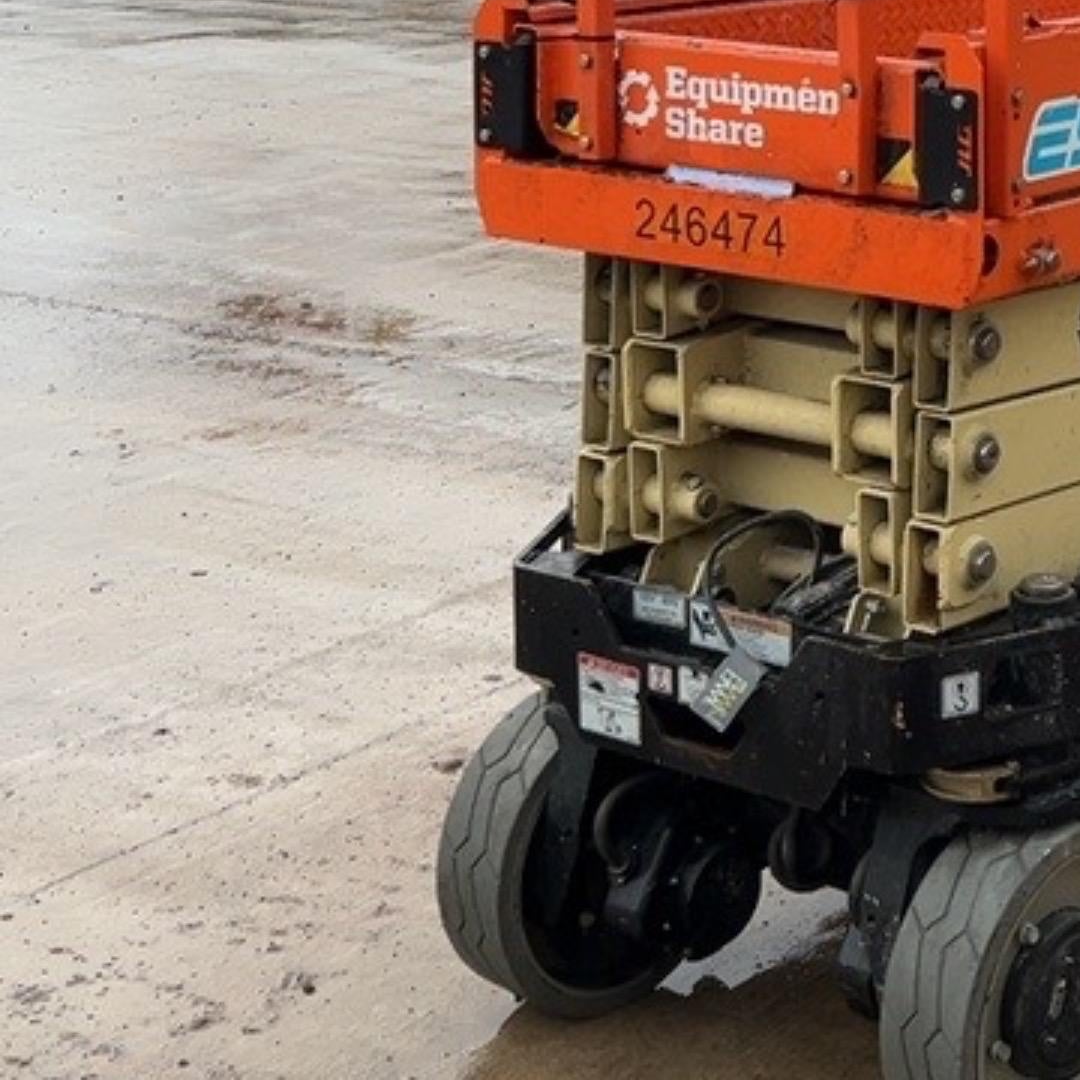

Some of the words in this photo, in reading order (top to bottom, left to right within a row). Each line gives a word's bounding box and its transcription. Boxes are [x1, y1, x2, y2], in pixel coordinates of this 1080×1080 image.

[665, 66, 840, 115] Equipmen
[665, 107, 763, 148] Share
[635, 198, 786, 258] 246474
